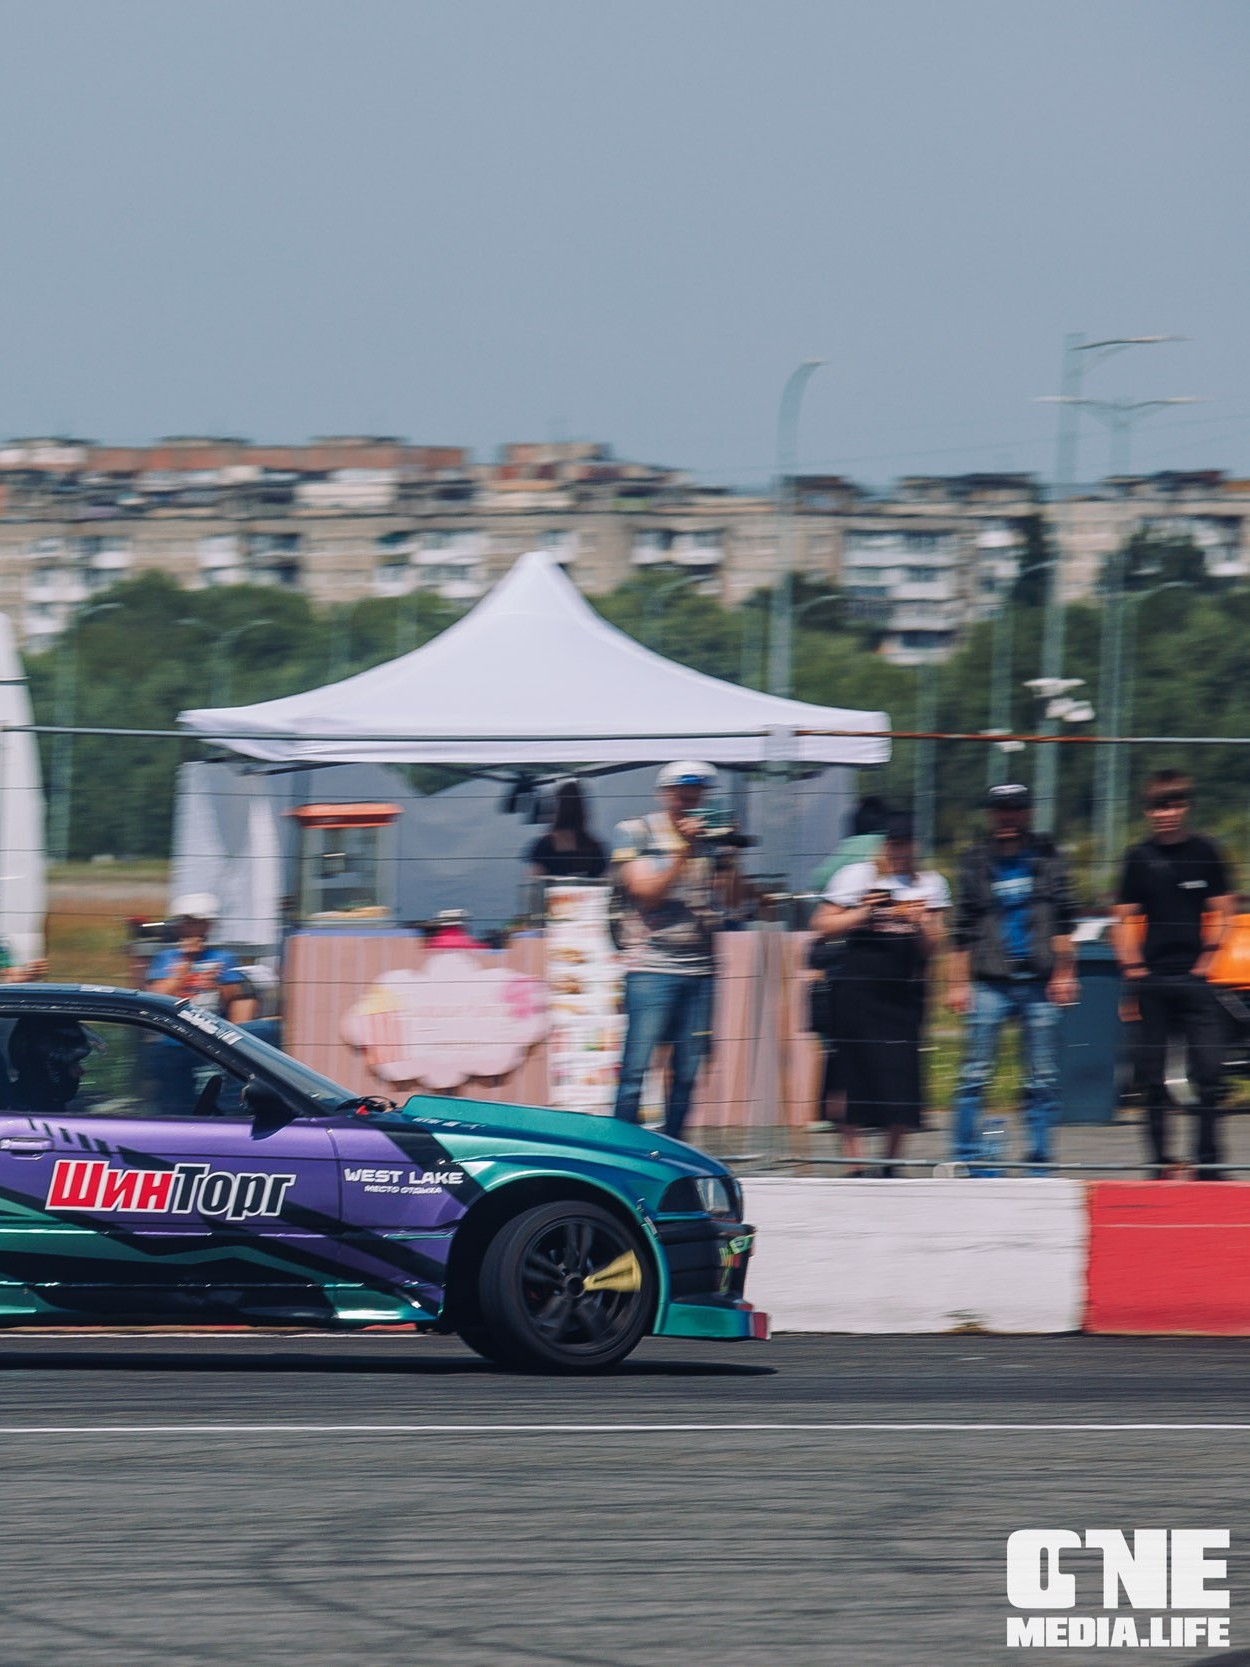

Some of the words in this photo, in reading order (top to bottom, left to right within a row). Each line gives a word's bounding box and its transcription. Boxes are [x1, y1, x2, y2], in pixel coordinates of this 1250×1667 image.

[343, 1168, 403, 1183] WEST
[409, 1171, 464, 1185] LAKE
[45, 1159, 295, 1220] ШинТорг
[364, 1185, 399, 1194] МЕСТО
[400, 1186, 443, 1195] ОТДЫХА
